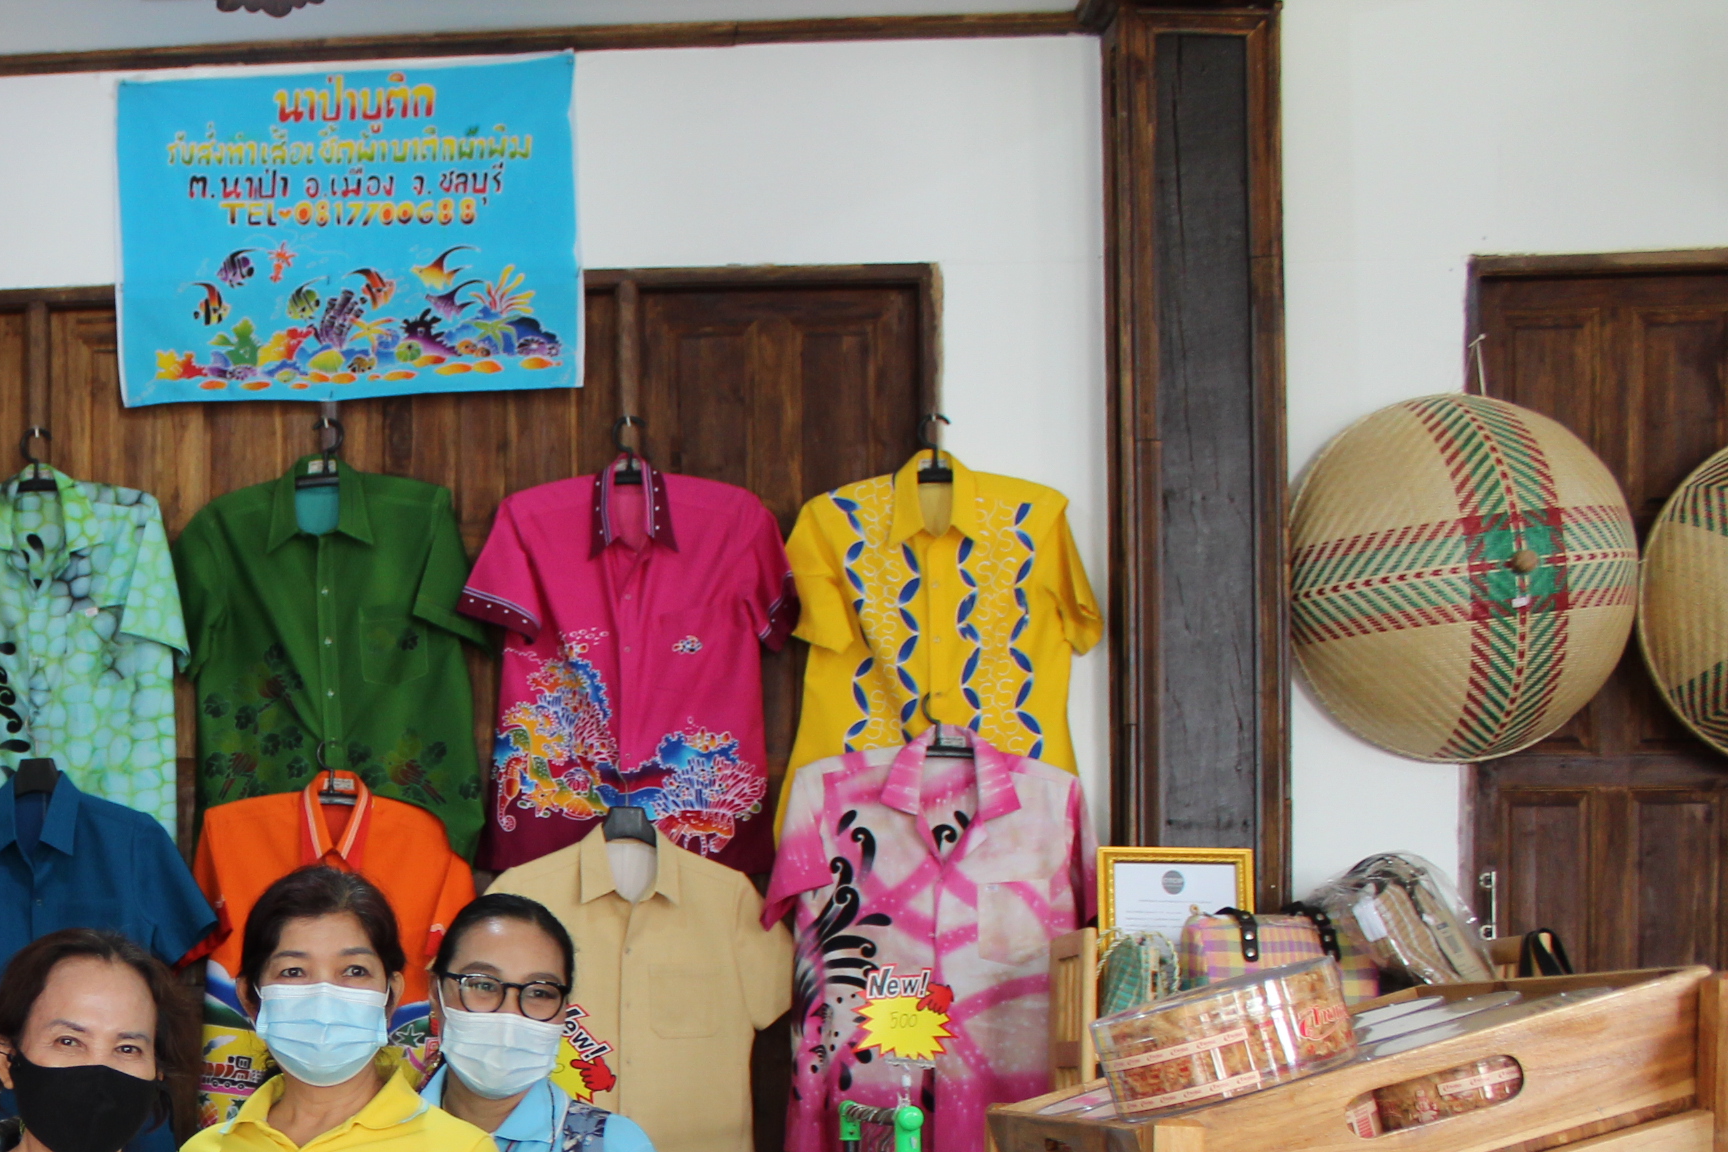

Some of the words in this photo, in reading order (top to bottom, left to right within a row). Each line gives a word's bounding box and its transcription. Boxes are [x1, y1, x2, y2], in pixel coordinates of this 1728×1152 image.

[274, 71, 436, 133] นาป่าบูติก
[189, 168, 288, 199] ต.นาป่า
[305, 167, 394, 198] อ.เมือง
[867, 966, 930, 998] New!
[890, 1011, 918, 1030] 500
